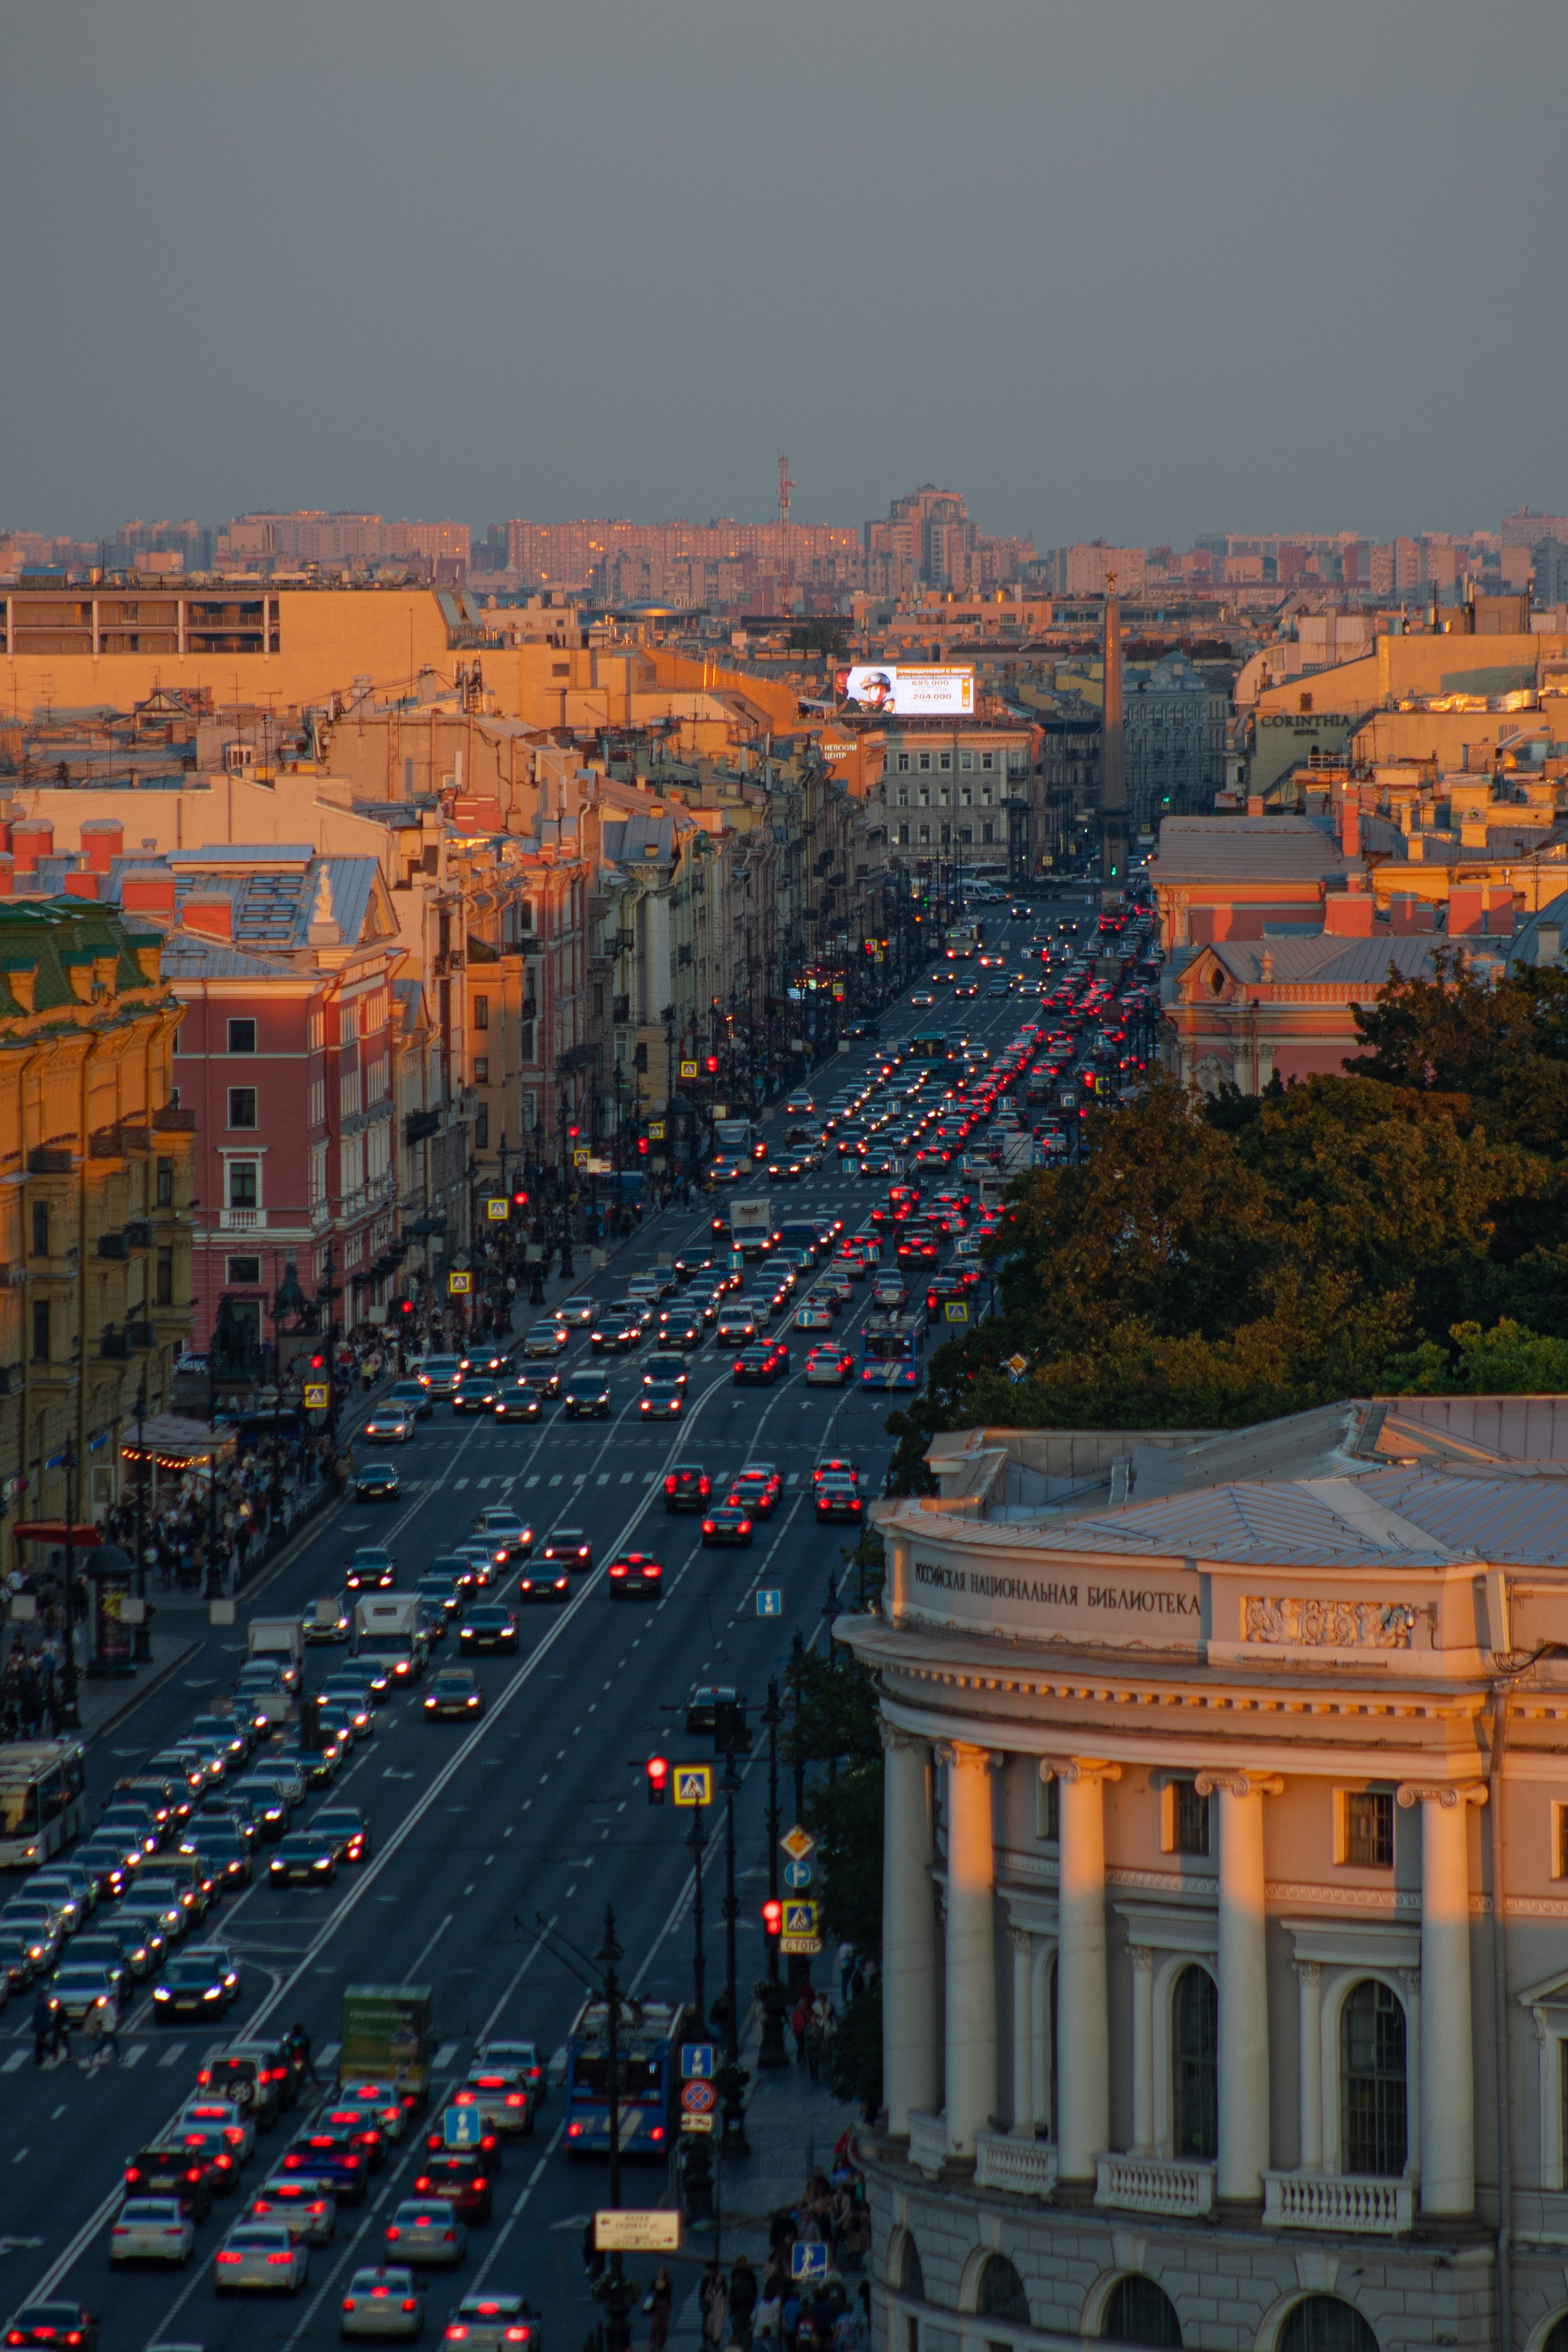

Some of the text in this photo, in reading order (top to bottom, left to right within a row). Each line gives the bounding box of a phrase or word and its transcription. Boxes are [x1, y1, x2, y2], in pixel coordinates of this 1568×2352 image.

[674, 597, 707, 607] ОЛИМП
[1261, 715, 1350, 727] CORINTHIA
[824, 752, 846, 761] ЦЕНТР
[915, 1562, 1201, 1616] РОССИЙСКАЯ НАЦИОНАЛЬНАЯ БИБЛИОТЕКА
[786, 1940, 815, 1951] СТОП
